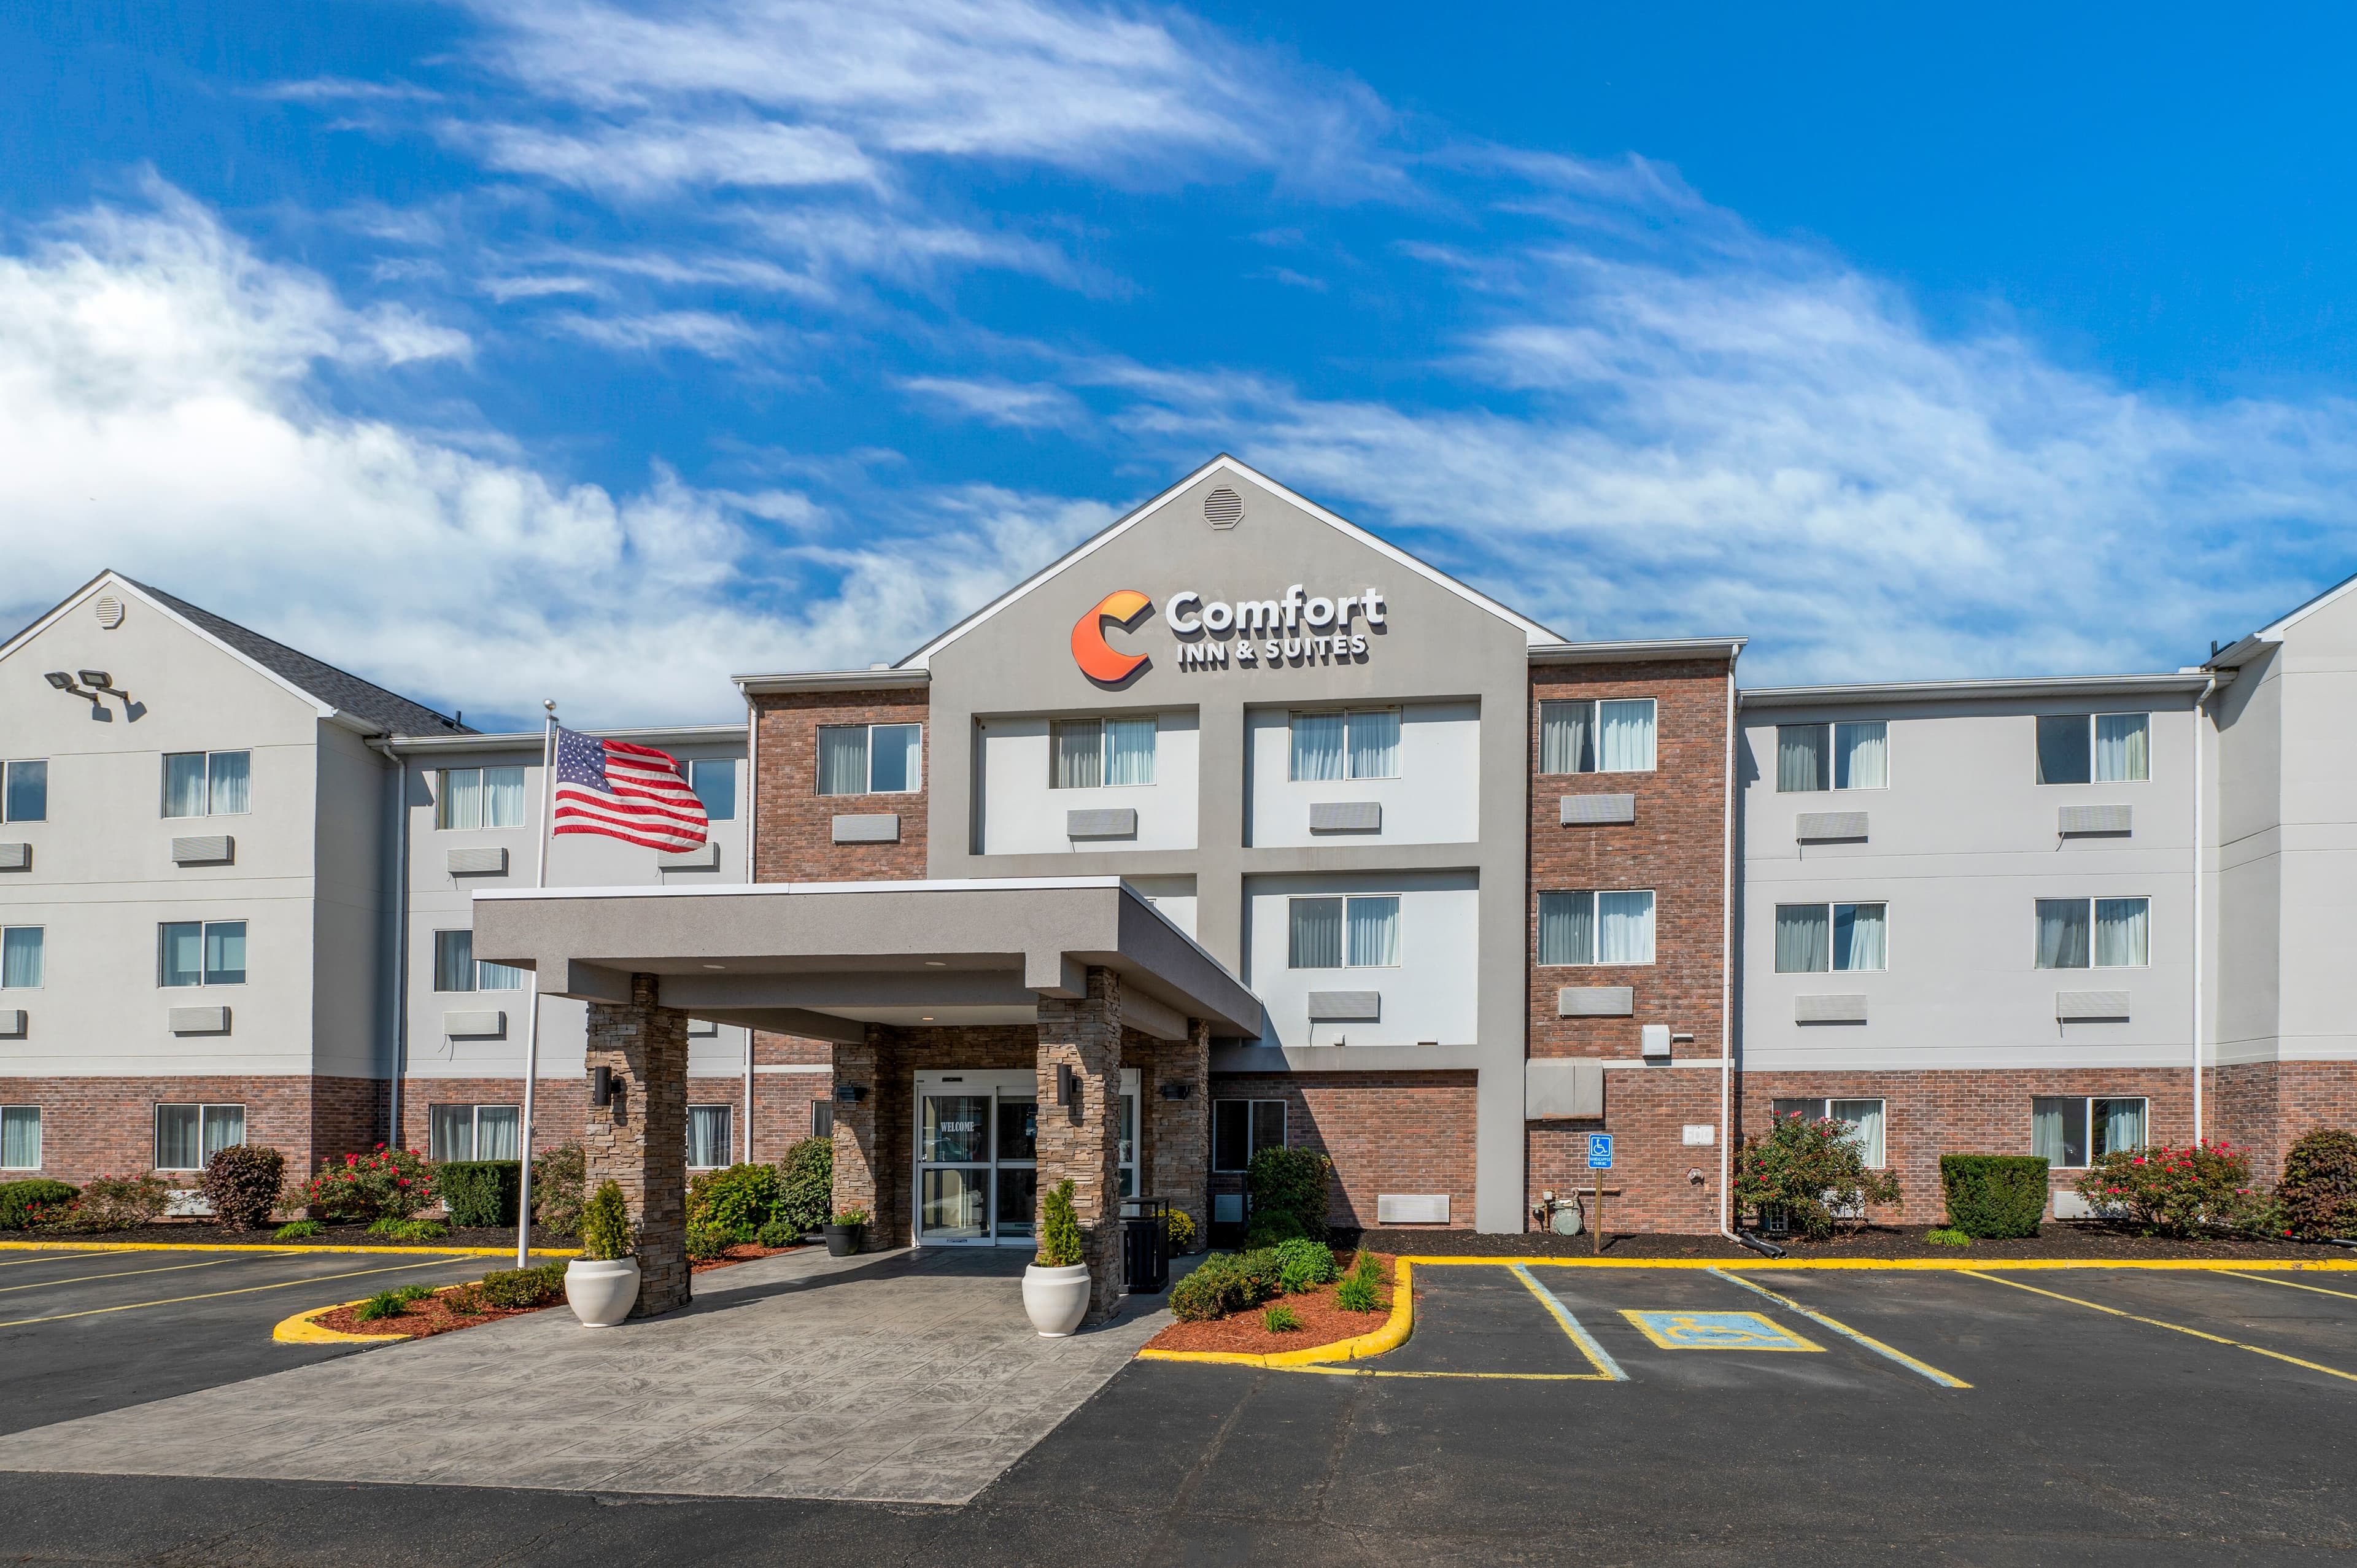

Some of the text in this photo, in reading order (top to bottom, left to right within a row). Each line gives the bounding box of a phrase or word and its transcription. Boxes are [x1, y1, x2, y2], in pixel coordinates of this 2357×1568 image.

[1166, 584, 1385, 633] Comfort
[1177, 634, 1366, 663] INN & SUITES
[941, 1122, 974, 1132] WELCOME
